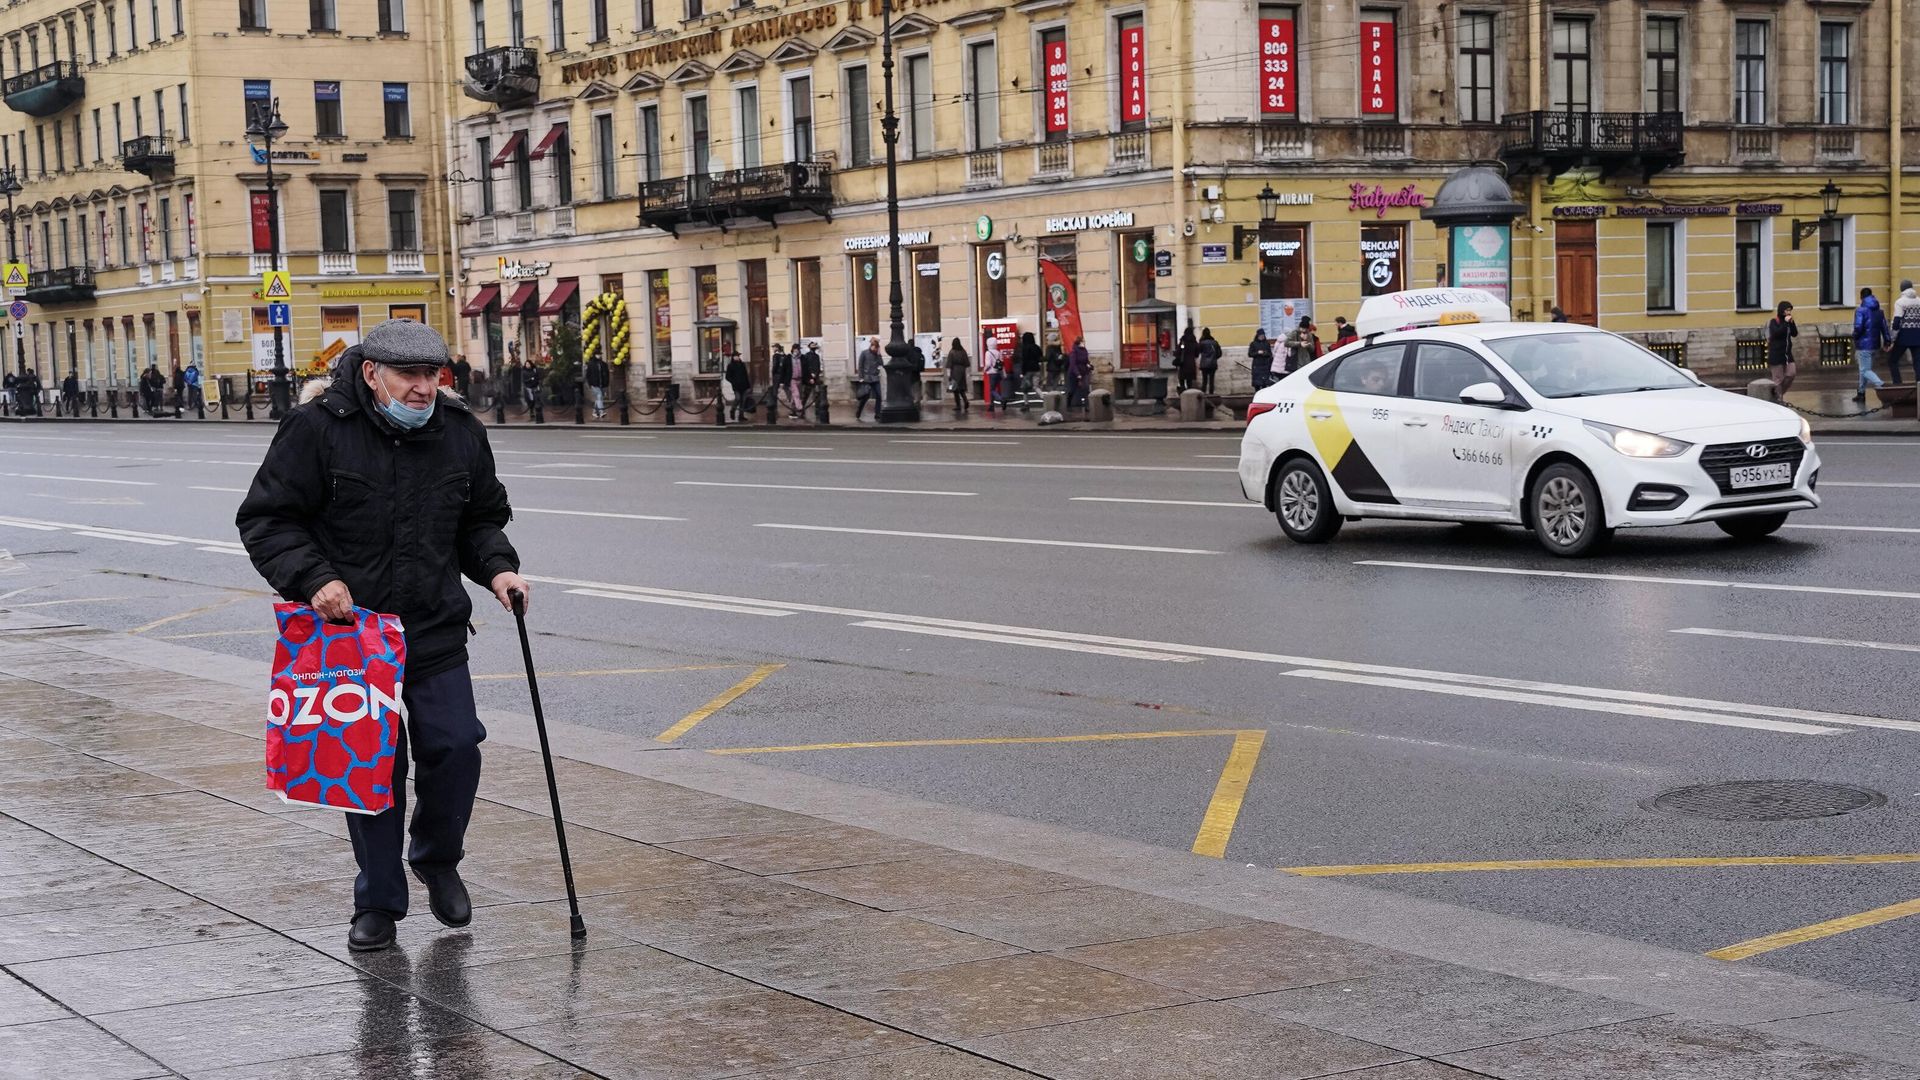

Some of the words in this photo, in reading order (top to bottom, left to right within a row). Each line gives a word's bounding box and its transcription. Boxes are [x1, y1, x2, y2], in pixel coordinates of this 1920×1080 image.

[1271, 25, 1280, 37] 8
[1055, 47, 1061, 59] 8
[1264, 42, 1288, 54] 800
[1050, 63, 1067, 76] 800
[1264, 60, 1288, 72] 333
[1372, 27, 1383, 108] ПРОДАЮ
[1131, 32, 1140, 116] ПРОДАЮ
[1051, 80, 1067, 93] 333
[1268, 77, 1285, 89] 24
[1054, 97, 1065, 109] 24
[1268, 95, 1285, 107] 31
[1054, 113, 1066, 125] 31
[1277, 193, 1313, 205] AURANT
[1349, 183, 1426, 218] Katyusha
[1046, 216, 1086, 232] ВЕНСКАЯ
[1088, 211, 1134, 230] КОФЕЙНЯ
[844, 234, 890, 250] COFFEESHOP
[898, 231, 931, 245] OMPANY
[1259, 241, 1301, 250] COFFEESHOP
[1361, 240, 1399, 251] ВЕНСКАЯ
[1266, 249, 1294, 257] COMPANY
[1365, 251, 1397, 259] КОФЕЙНЯ
[1374, 266, 1388, 278] 24
[1393, 293, 1453, 308] Яндекс
[1452, 290, 1489, 305] Такси
[1372, 408, 1389, 420] 956
[1441, 415, 1476, 435] Яндекс
[1479, 418, 1504, 438] Такси
[1461, 448, 1477, 462] 366
[1479, 450, 1490, 463] 66
[1492, 453, 1503, 465] 66
[267, 682, 403, 726] OZON
